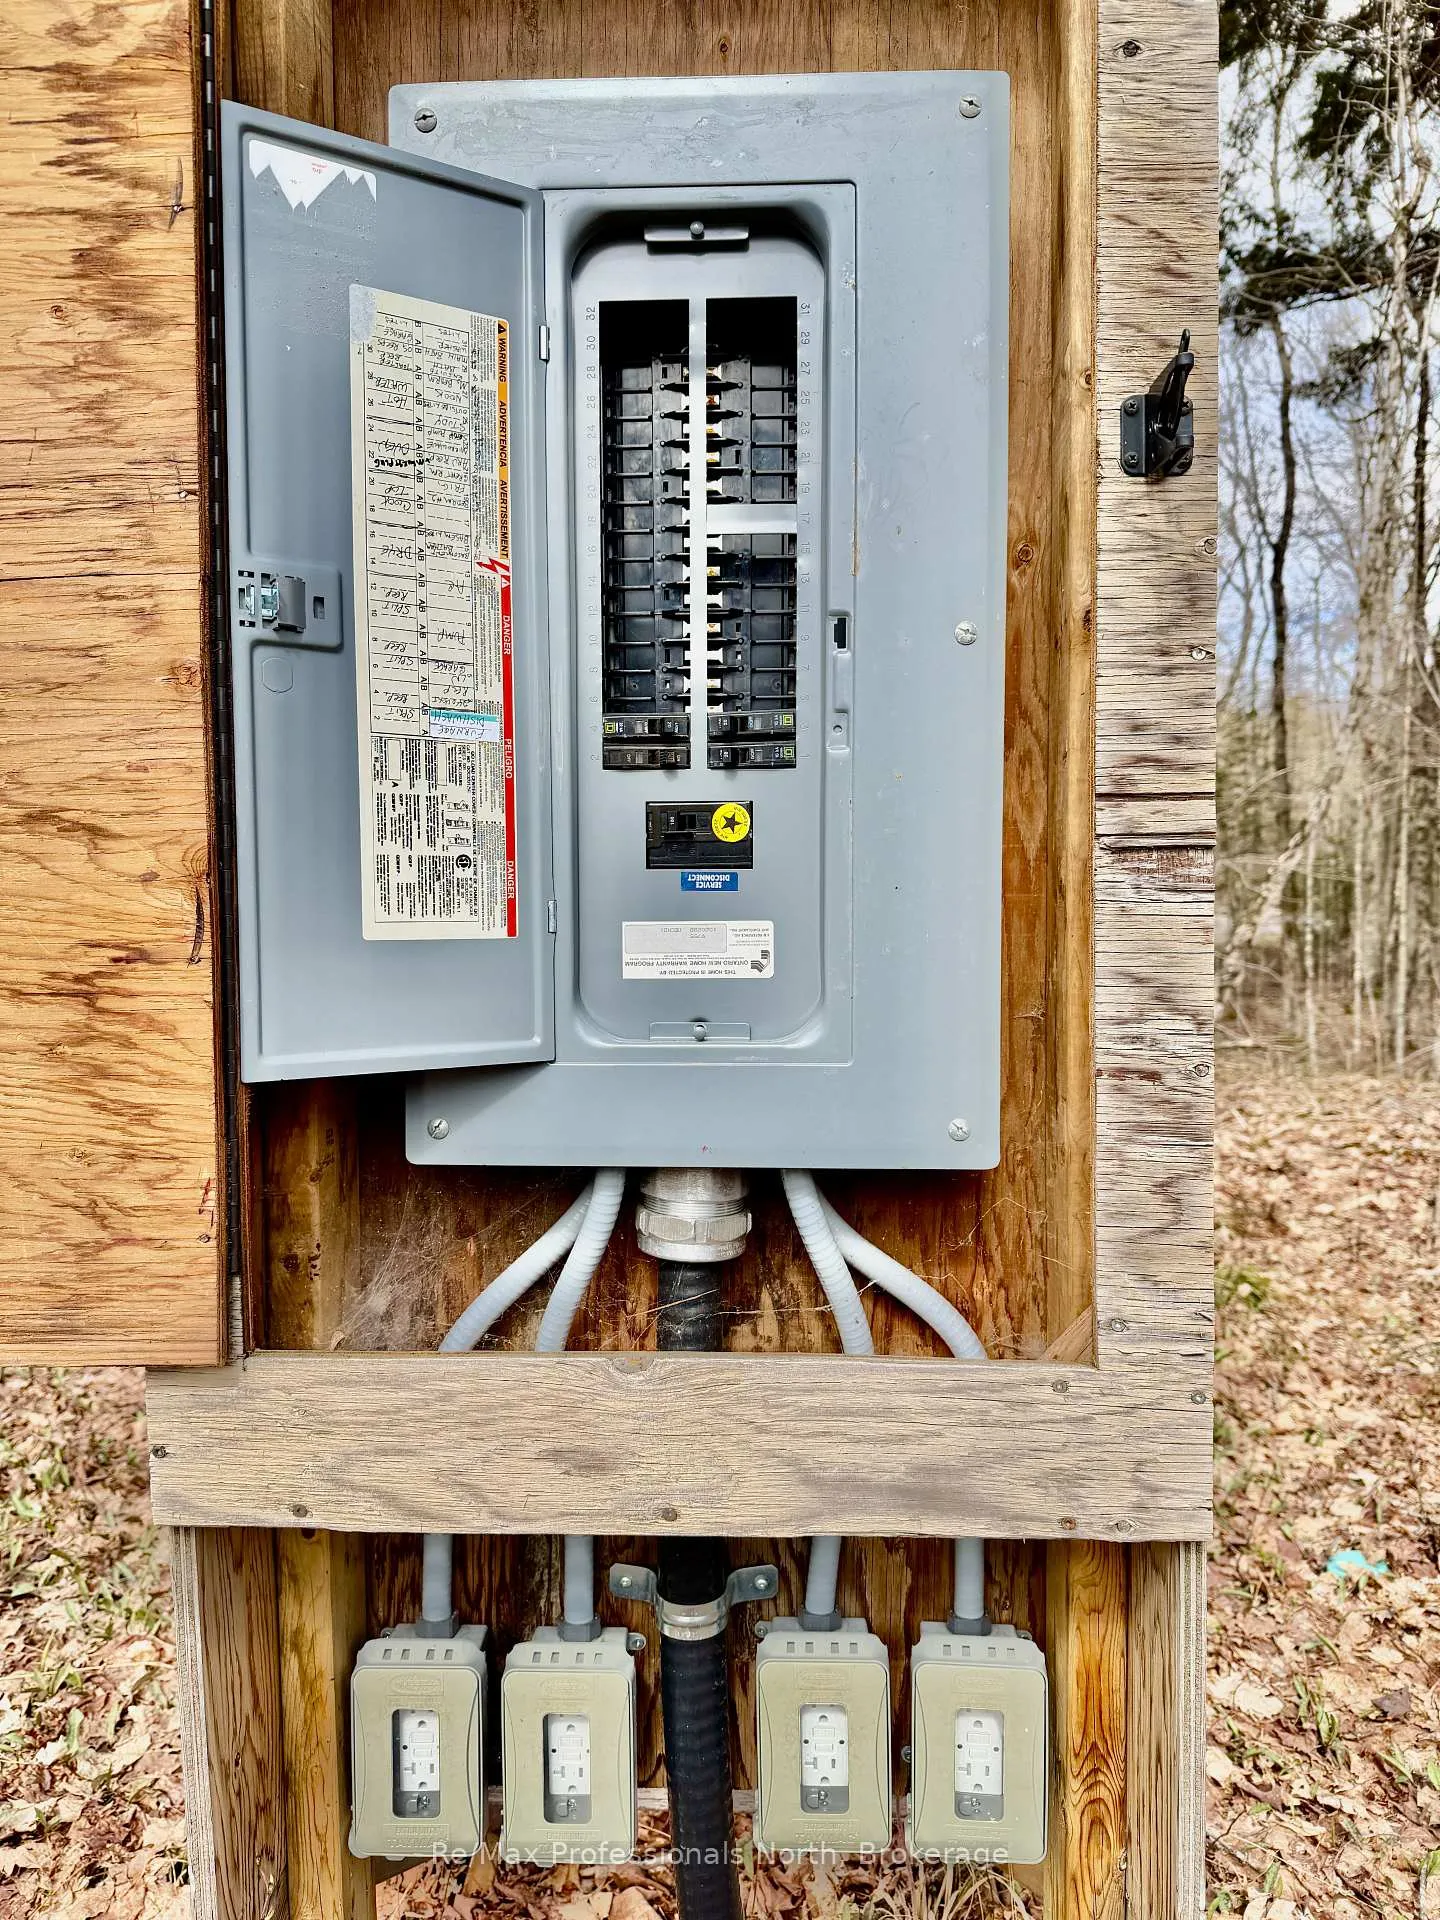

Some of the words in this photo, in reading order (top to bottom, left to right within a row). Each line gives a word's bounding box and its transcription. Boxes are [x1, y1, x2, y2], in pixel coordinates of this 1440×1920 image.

[586, 307, 596, 320] 32
[801, 303, 810, 314] 31
[586, 336, 596, 350] 30
[801, 331, 810, 344] 29
[499, 338, 507, 382] WARNING
[586, 366, 596, 379] 28
[801, 361, 810, 375] 27
[368, 398, 373, 406] 26
[382, 395, 407, 408] HOT
[586, 395, 596, 408] 26
[801, 391, 810, 404] 25
[586, 425, 596, 438] 24
[801, 421, 810, 435] 23
[369, 450, 374, 458] 22
[587, 456, 596, 469] 22
[369, 477, 374, 485] 20
[801, 482, 810, 494] 19
[500, 479, 509, 558] AVERTISSEMENT
[802, 512, 810, 523] 17
